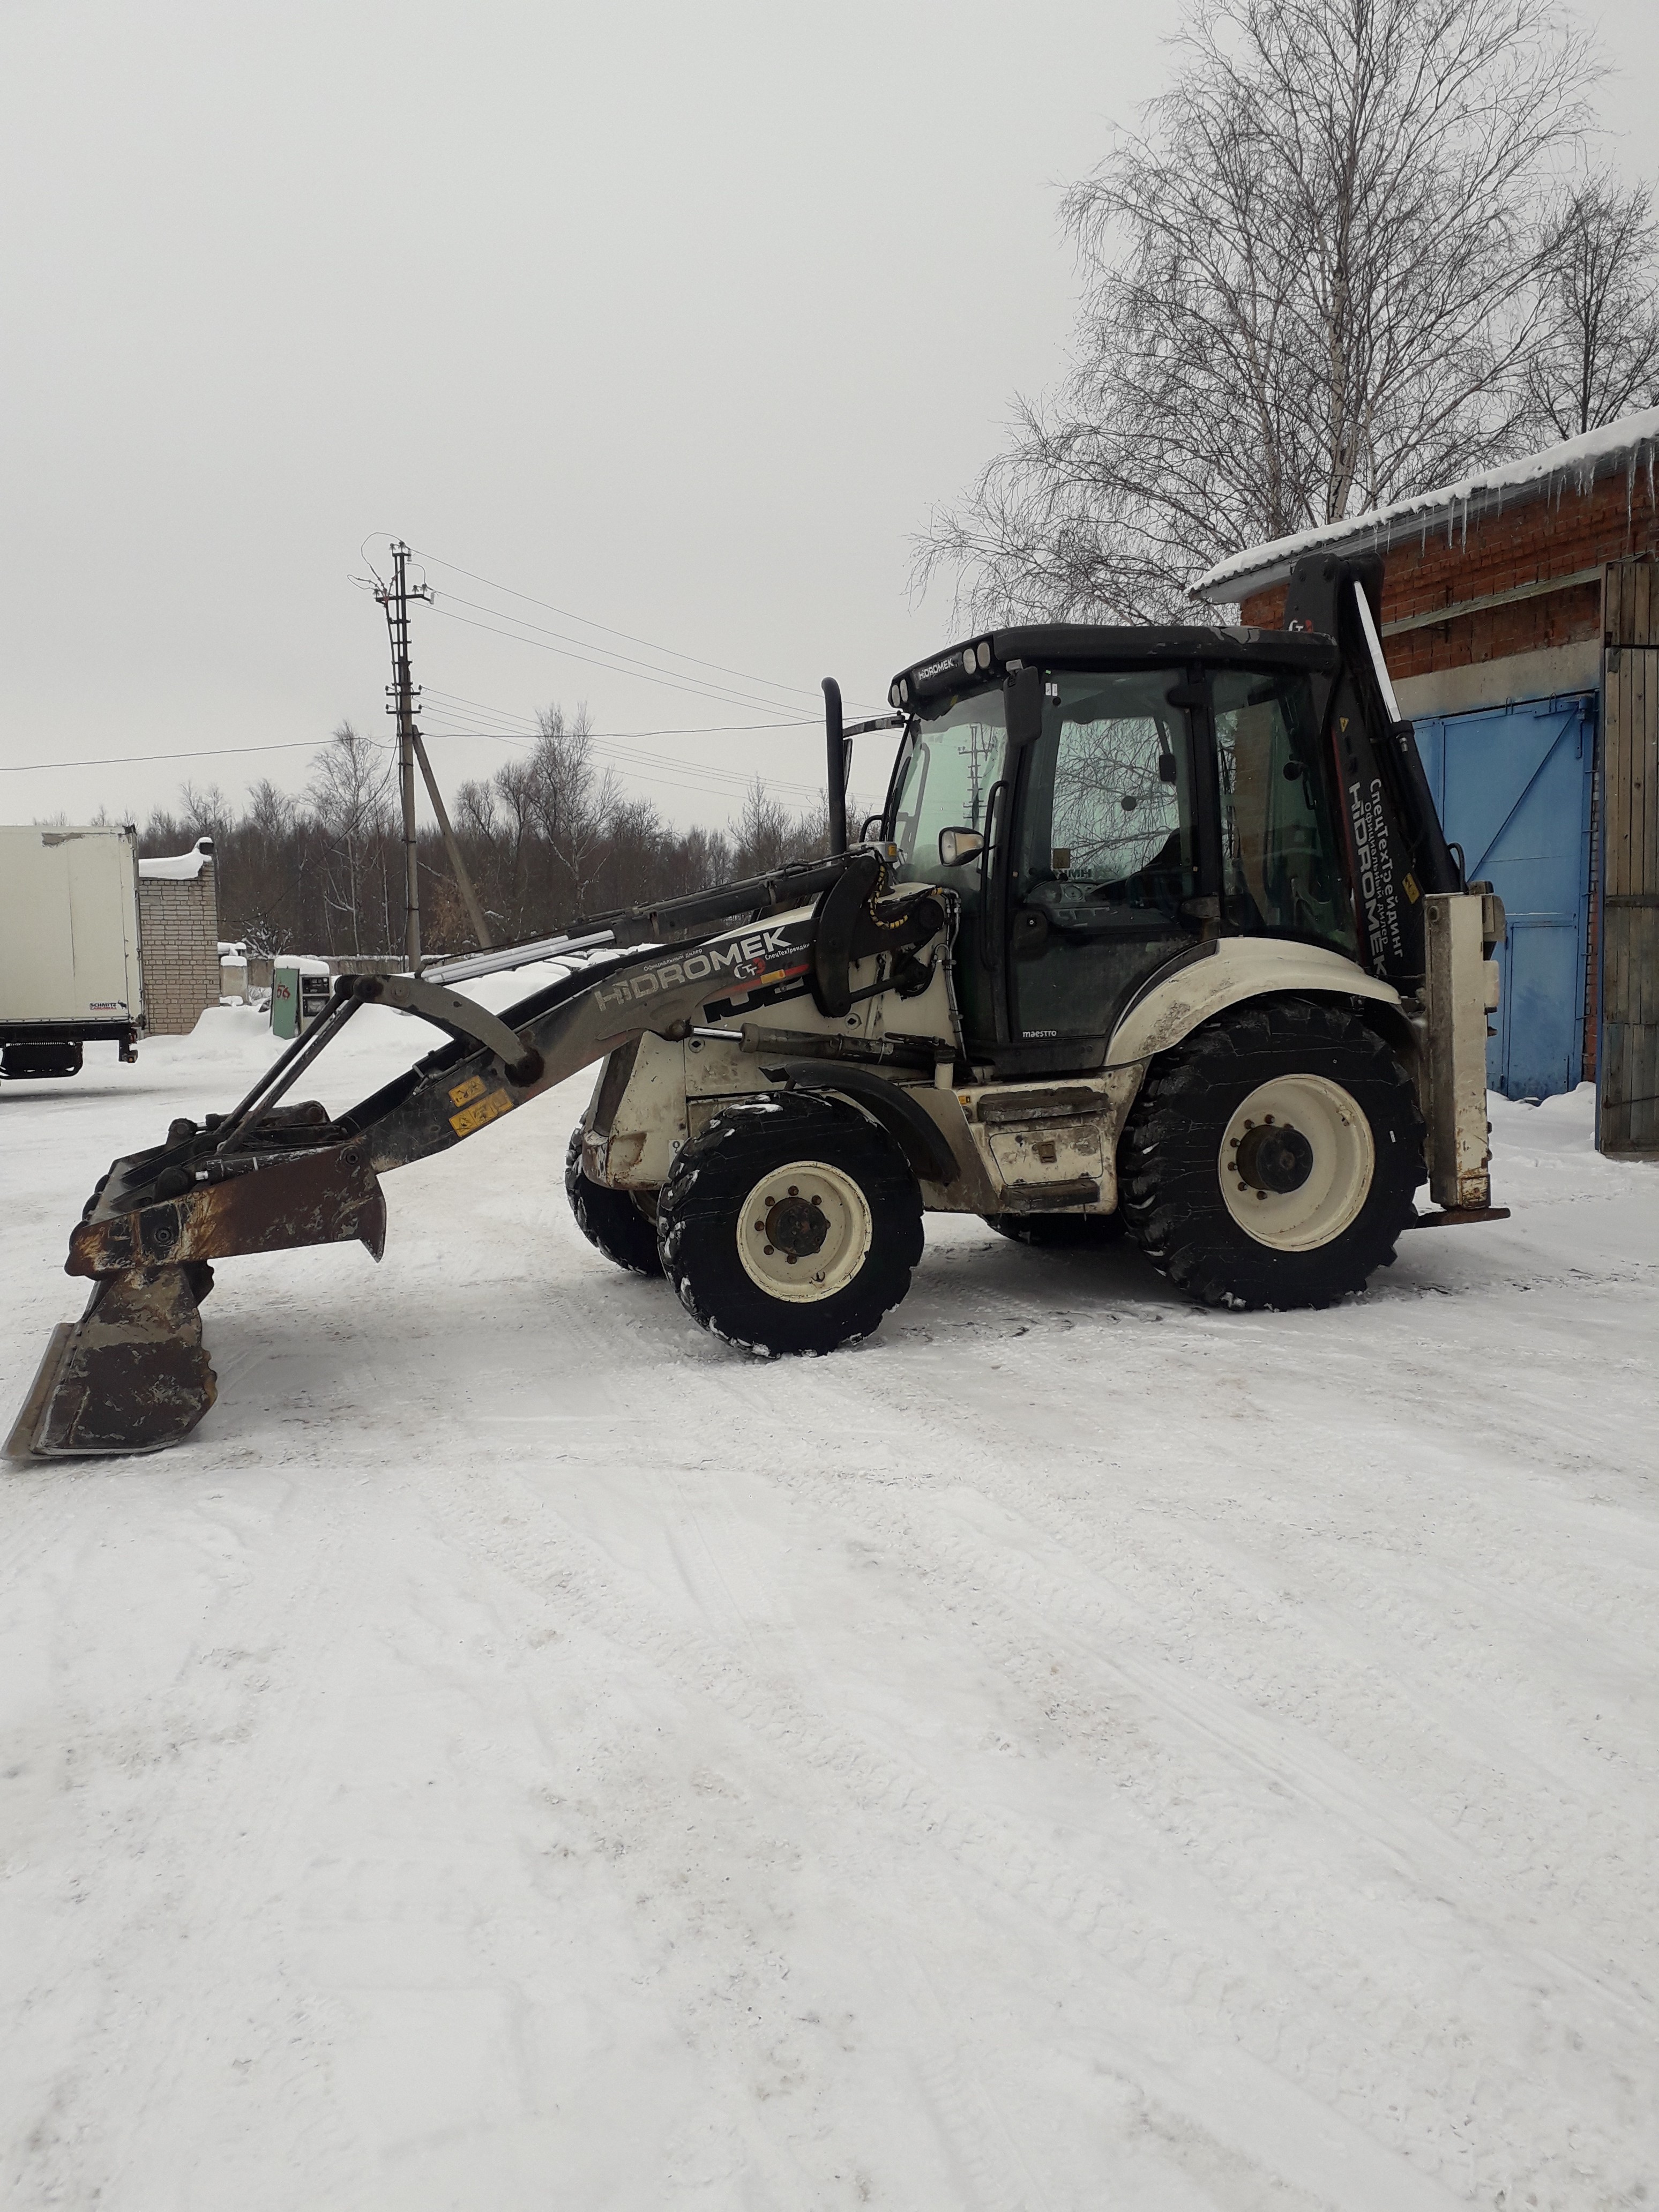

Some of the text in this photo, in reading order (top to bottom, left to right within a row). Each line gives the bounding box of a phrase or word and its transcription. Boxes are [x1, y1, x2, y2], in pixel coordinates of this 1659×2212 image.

[1365, 802, 1388, 945] Официальный дилер
[1370, 779, 1403, 958] СпецТехТрейдинг
[276, 984, 291, 1000] 56
